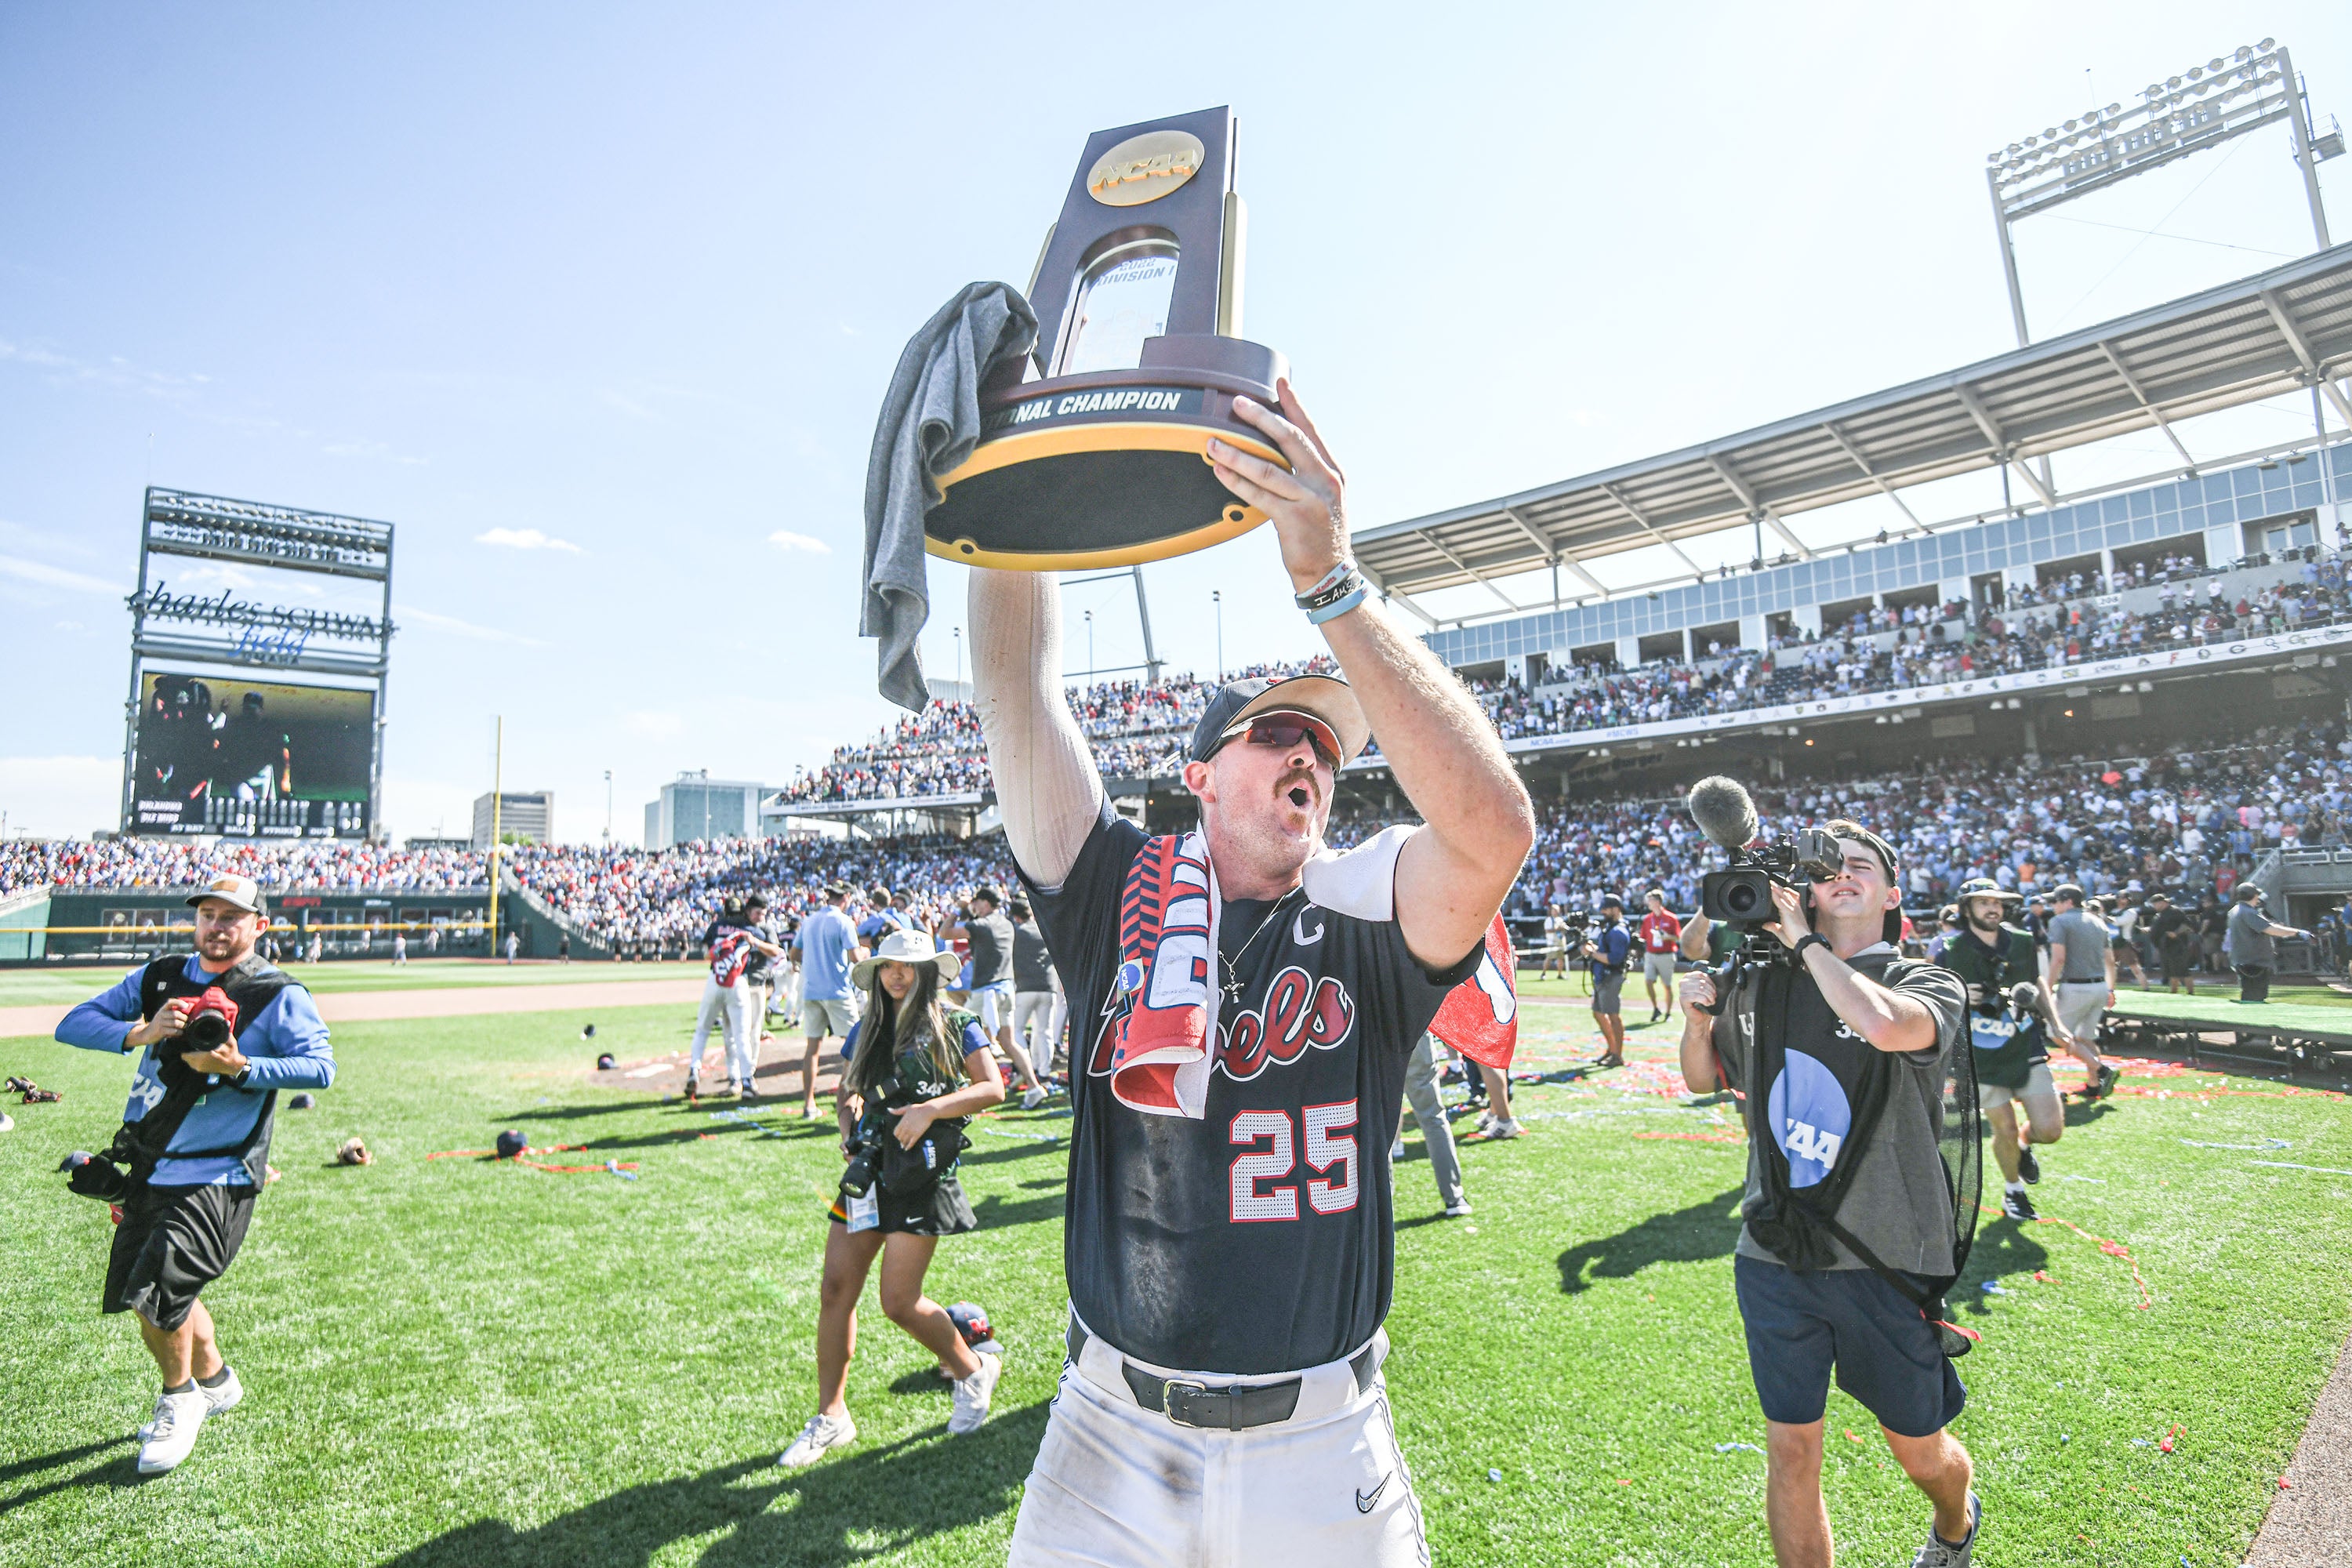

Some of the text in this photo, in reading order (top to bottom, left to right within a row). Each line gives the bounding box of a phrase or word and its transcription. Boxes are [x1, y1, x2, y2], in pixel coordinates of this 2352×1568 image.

[1092, 149, 1198, 194] NCAA
[1097, 267, 1165, 286] DIVISION
[1058, 391, 1181, 416] CHAMPION
[227, 623, 310, 657] field
[1293, 903, 1325, 946] C
[1120, 967, 1130, 991] NCAA
[1229, 1098, 1359, 1223] 25
[1785, 1117, 1841, 1169] AA
